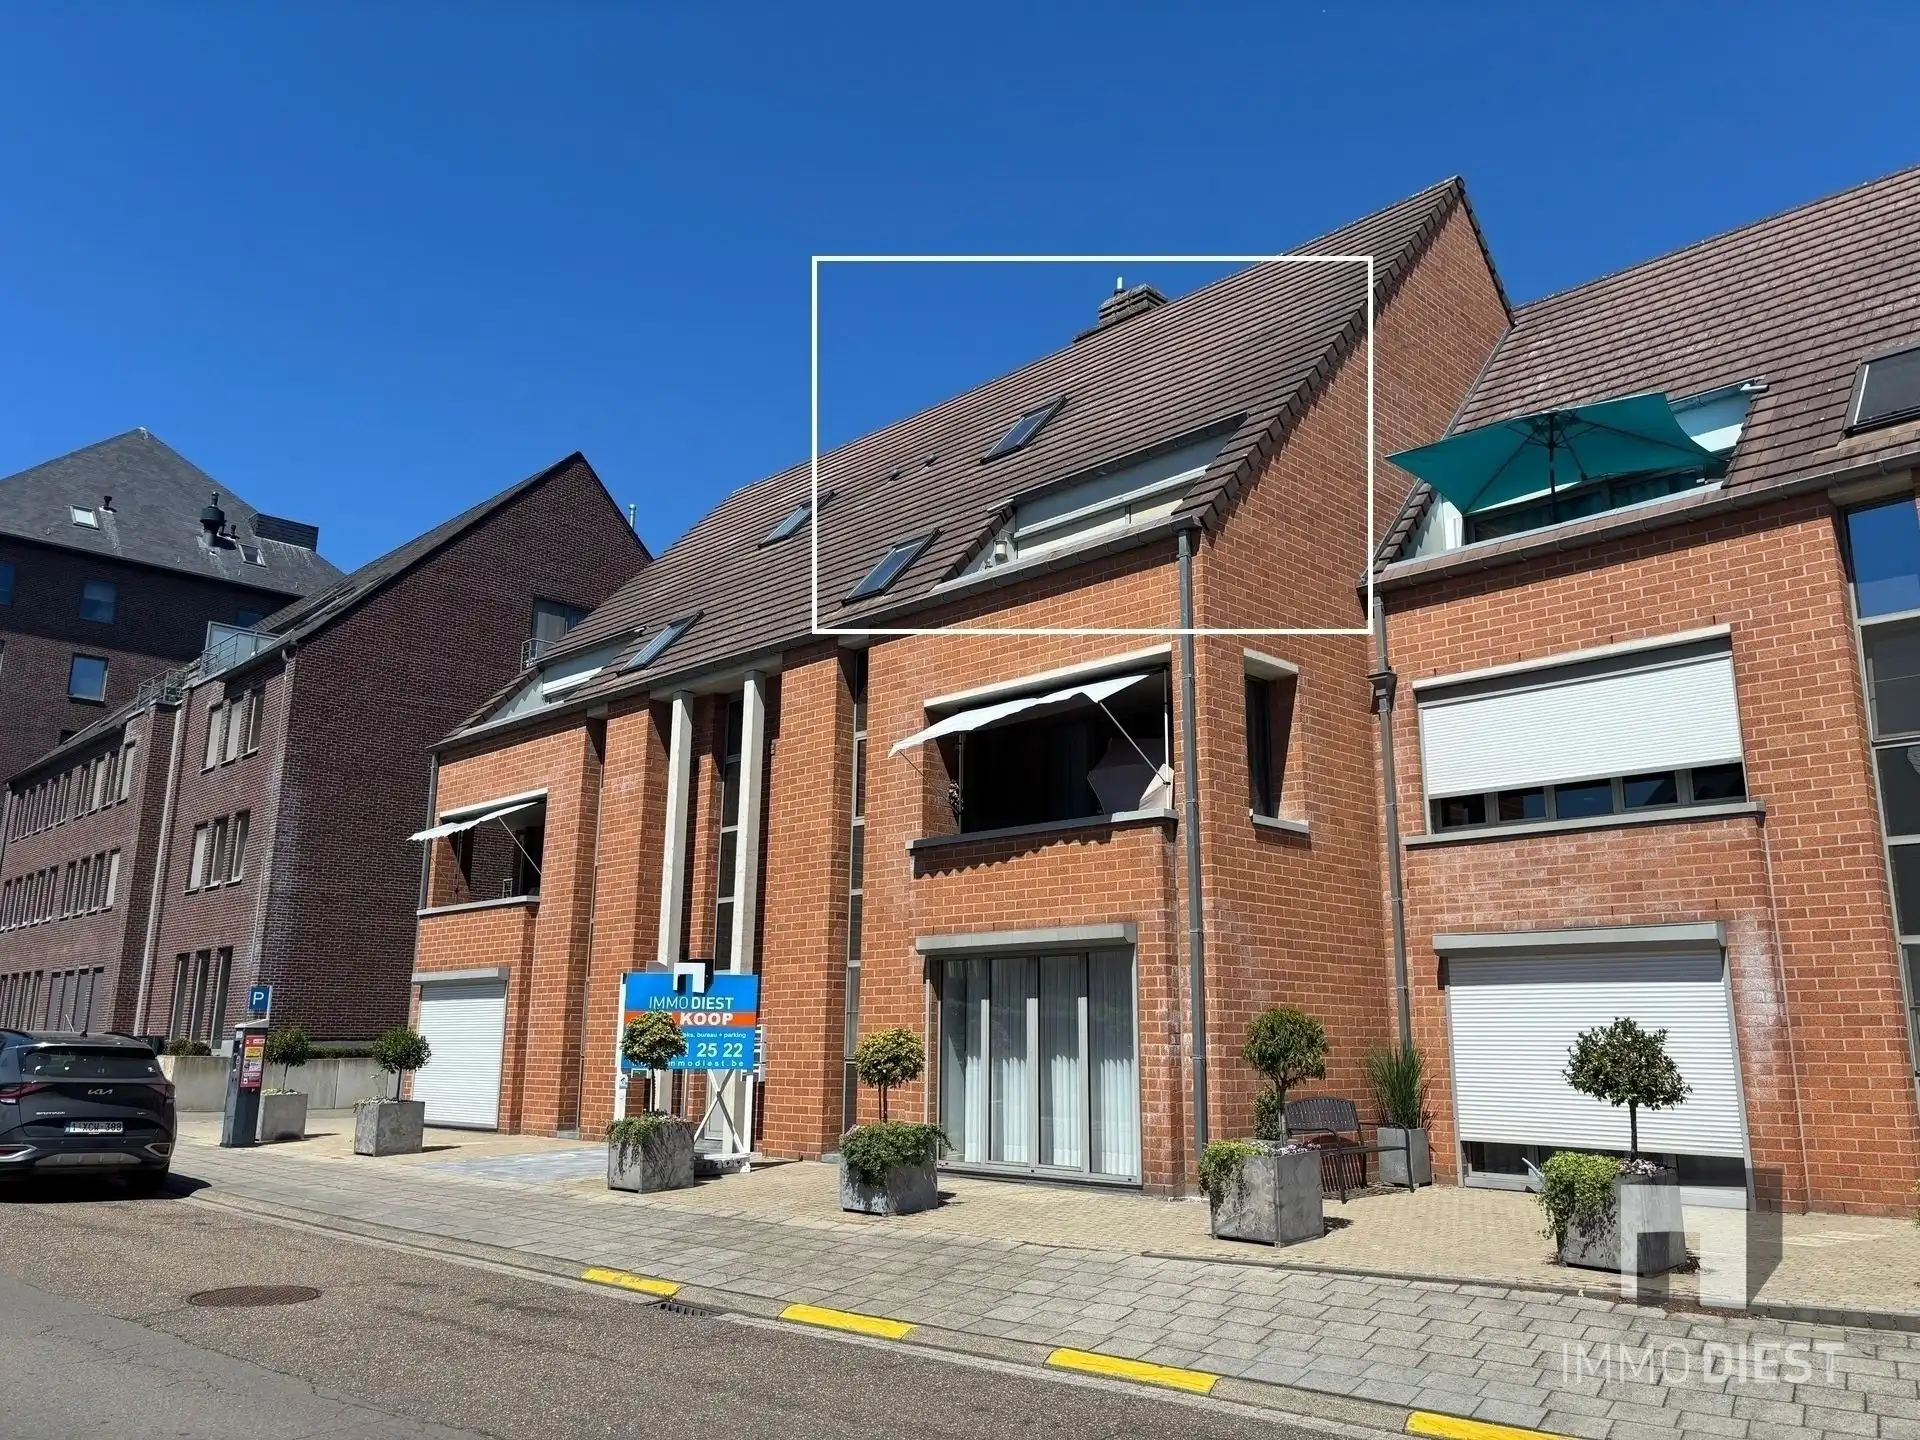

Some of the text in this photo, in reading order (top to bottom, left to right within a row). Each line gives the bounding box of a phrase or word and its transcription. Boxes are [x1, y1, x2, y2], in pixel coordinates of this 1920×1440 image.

[252, 991, 265, 1006] P
[649, 996, 734, 1010] IMMO DIEST
[680, 1012, 734, 1026] KOOP
[723, 1031, 747, 1039] parking
[696, 1042, 718, 1058] 25
[722, 1042, 744, 1058] 22
